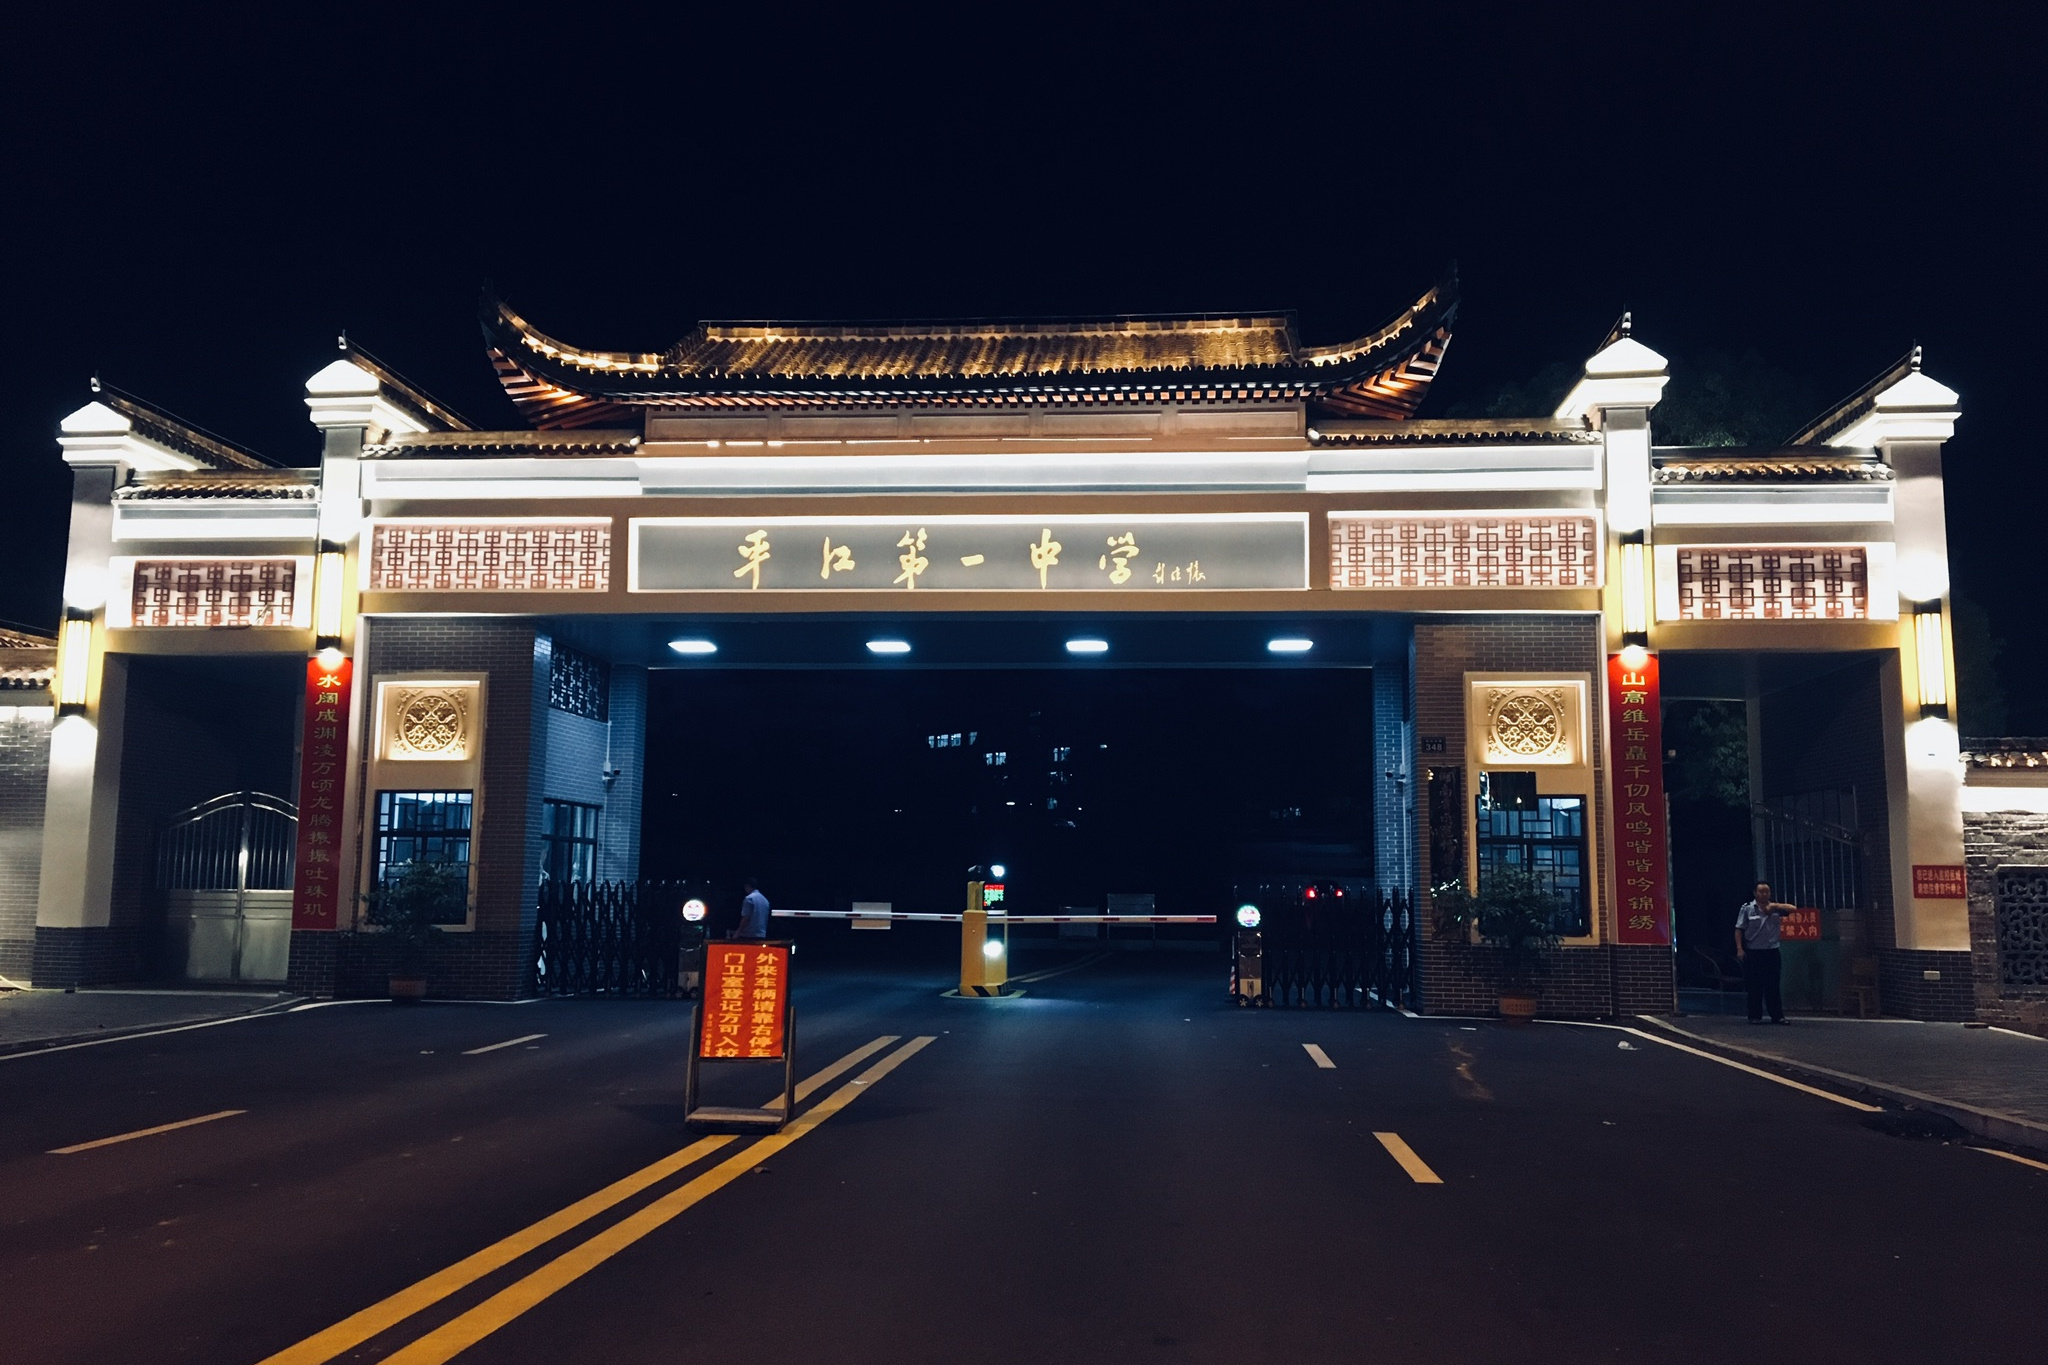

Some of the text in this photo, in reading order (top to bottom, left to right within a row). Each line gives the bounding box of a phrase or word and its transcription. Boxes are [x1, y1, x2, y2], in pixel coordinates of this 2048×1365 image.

[733, 527, 1140, 590] 平江第一中学
[1425, 743, 1443, 751] 348
[715, 952, 746, 1058] 门卫室登记方可入校
[748, 952, 779, 1058] 外来车辆请靠右停车
